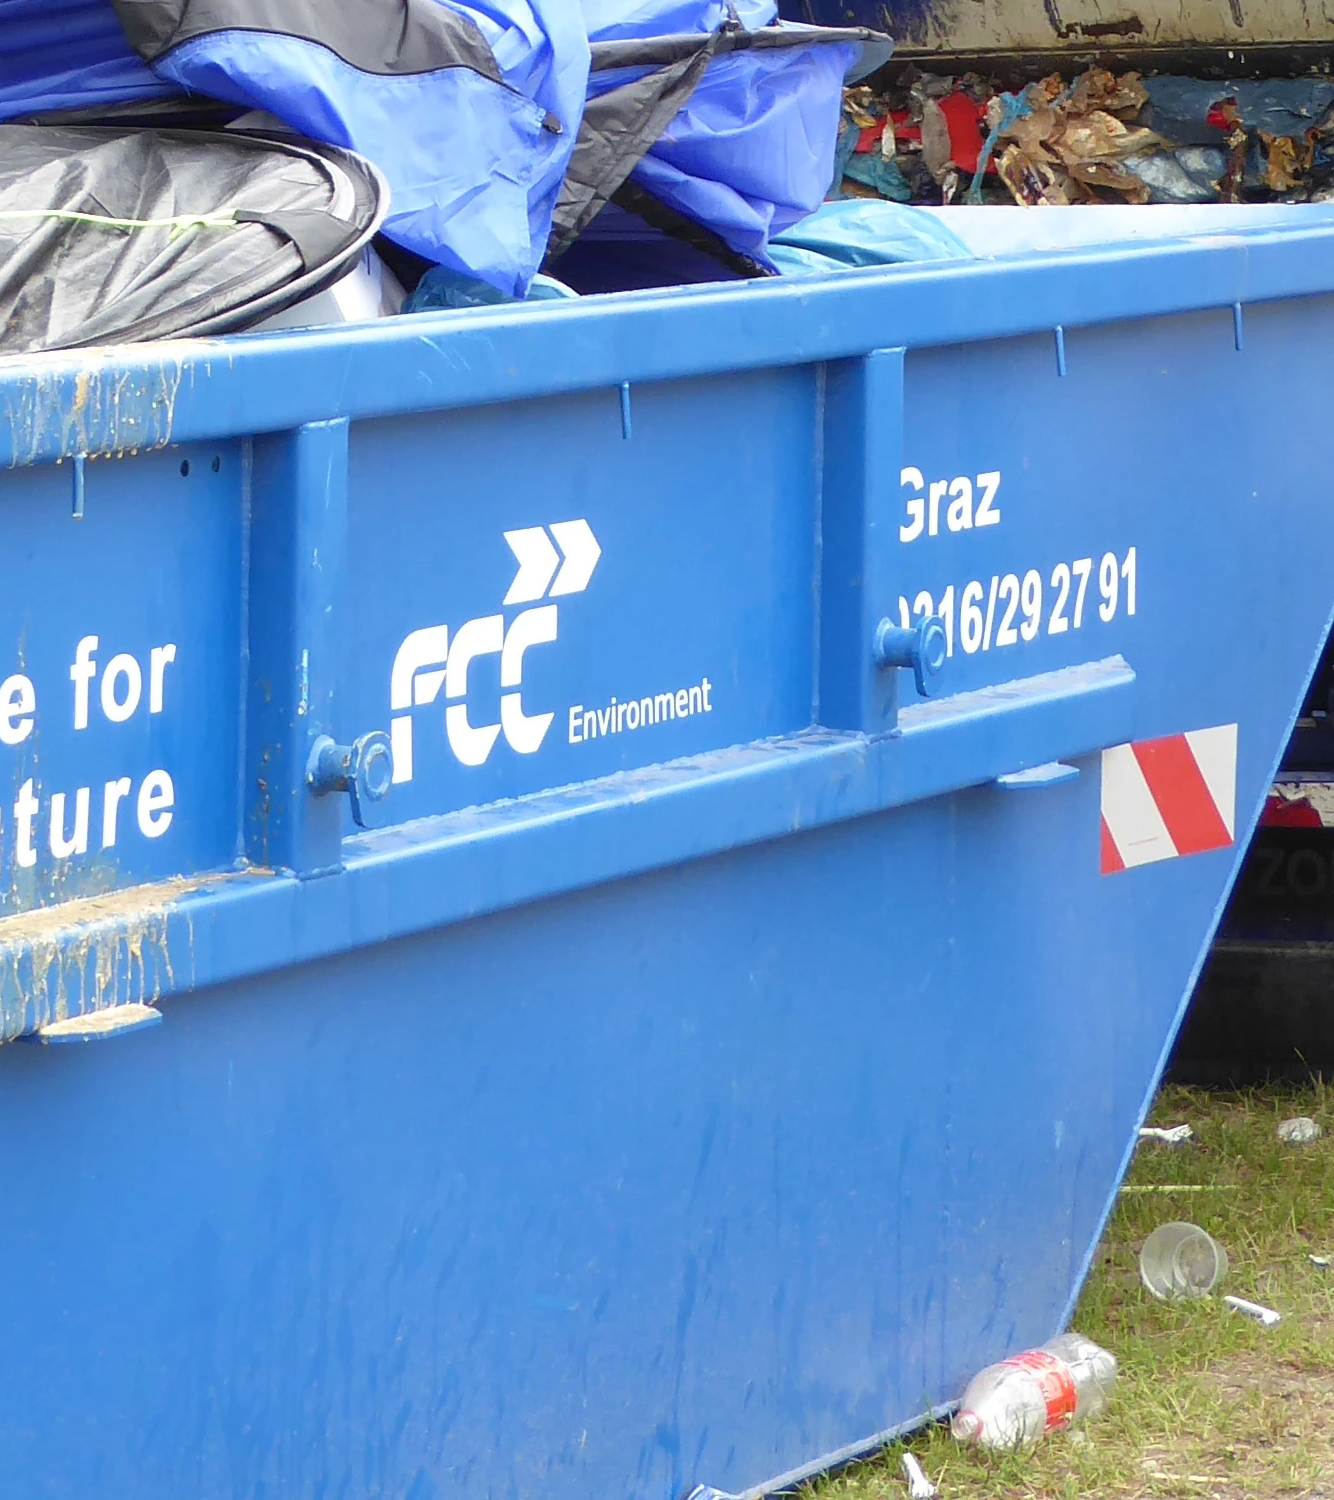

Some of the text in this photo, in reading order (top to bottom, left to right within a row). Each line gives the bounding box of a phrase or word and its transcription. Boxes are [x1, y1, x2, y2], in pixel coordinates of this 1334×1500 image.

[899, 466, 1001, 543] Graz
[69, 635, 177, 730] for
[391, 603, 558, 785] FCC
[569, 677, 713, 744] Environment
